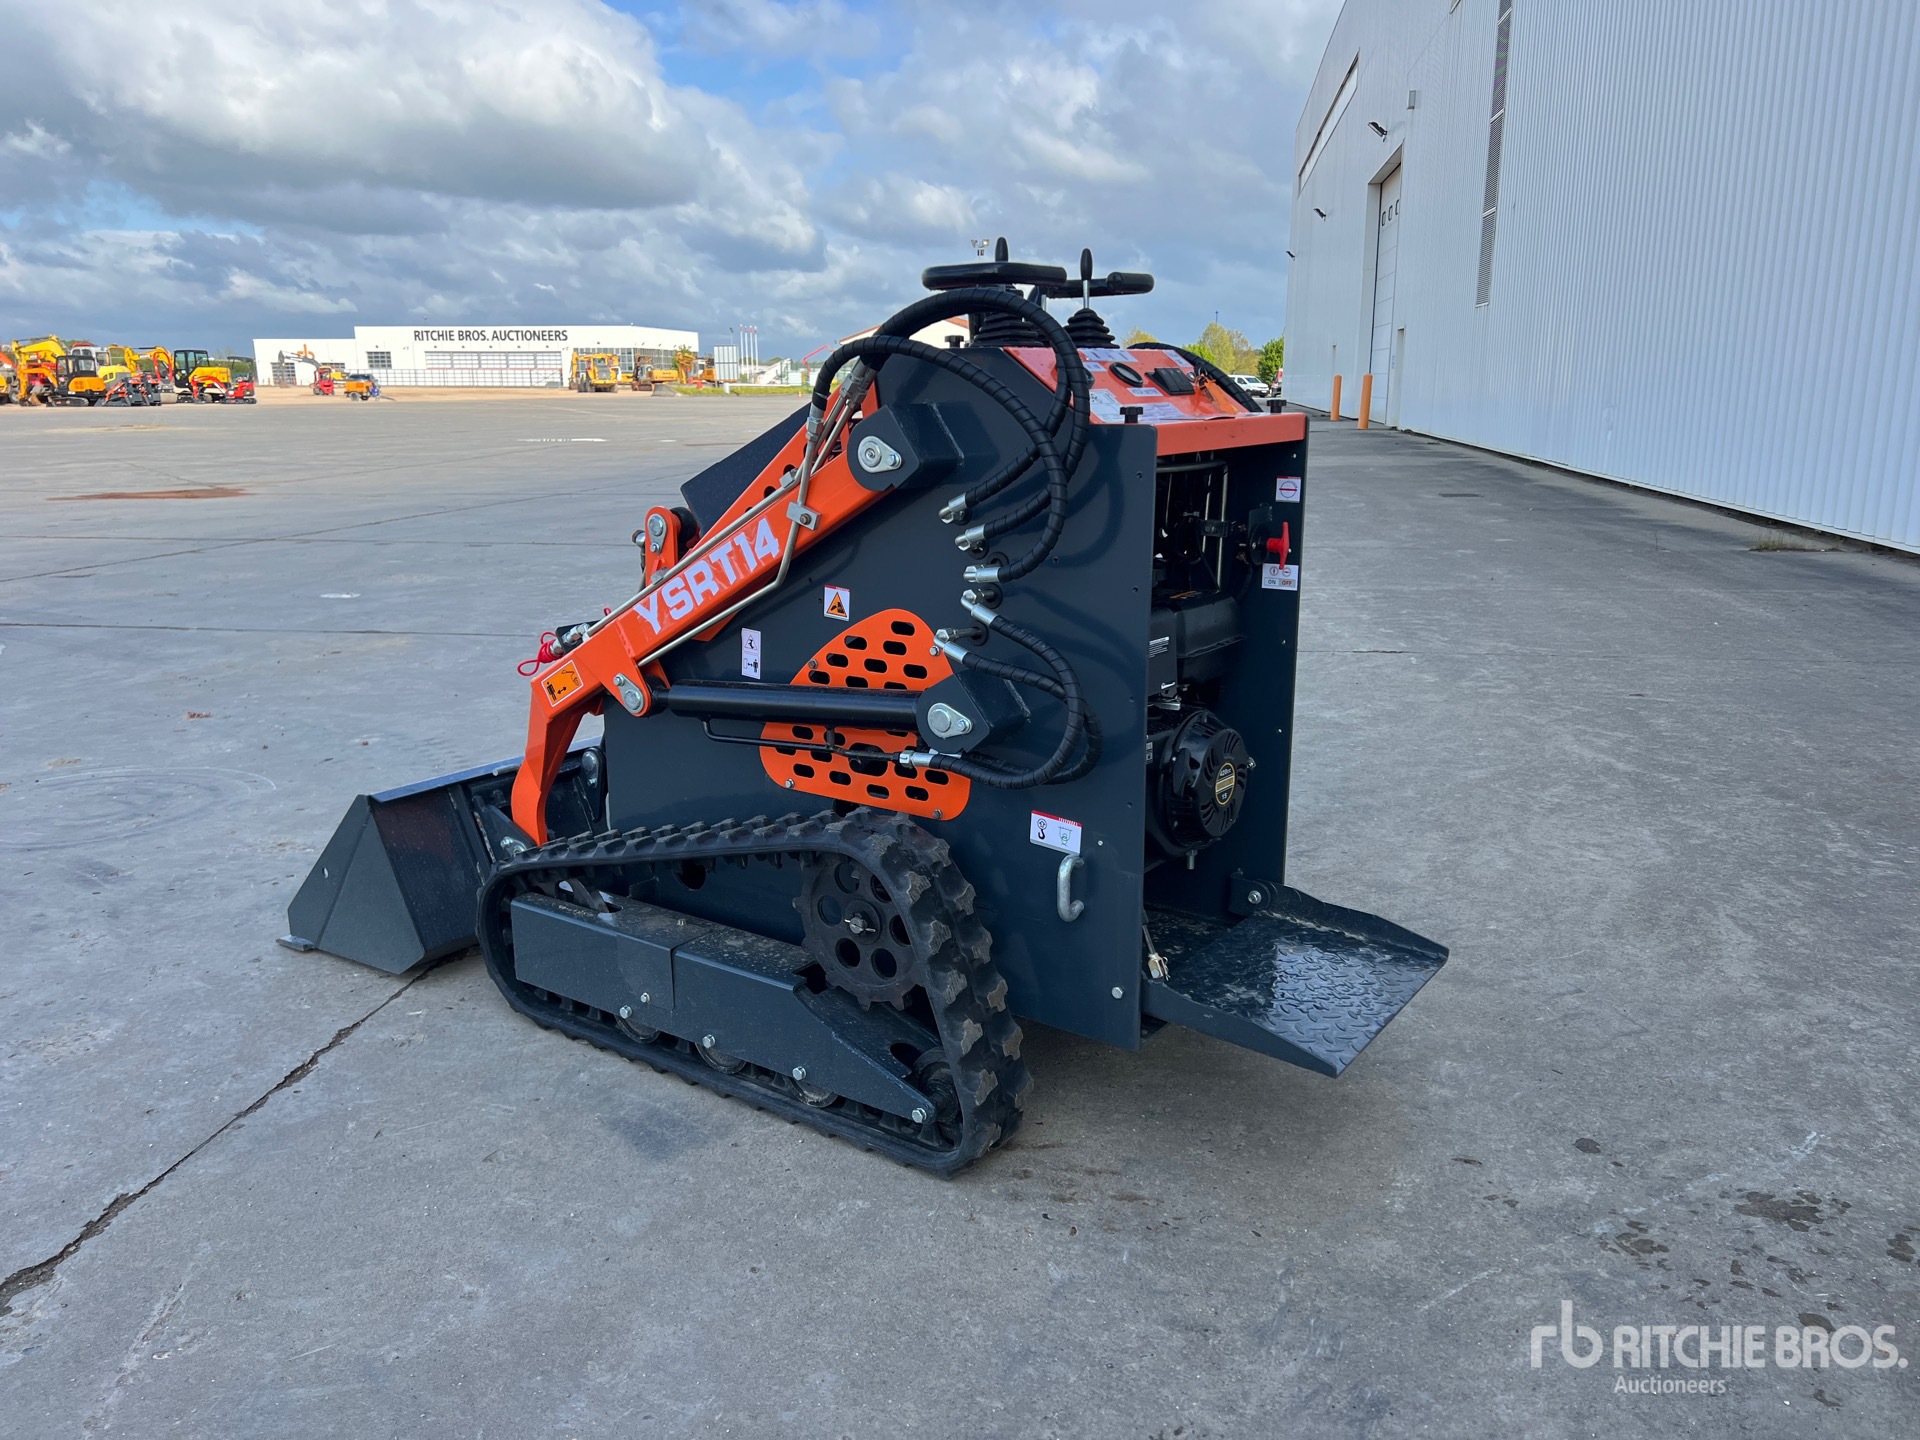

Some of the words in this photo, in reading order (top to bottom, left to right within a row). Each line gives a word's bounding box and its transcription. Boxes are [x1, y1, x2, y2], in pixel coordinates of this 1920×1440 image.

[413, 330, 455, 341] RITCHIE
[458, 330, 490, 341] BROS.
[492, 330, 568, 341] AUCTIONEERS
[633, 517, 780, 635] YSRT14
[1267, 577, 1276, 585] ON
